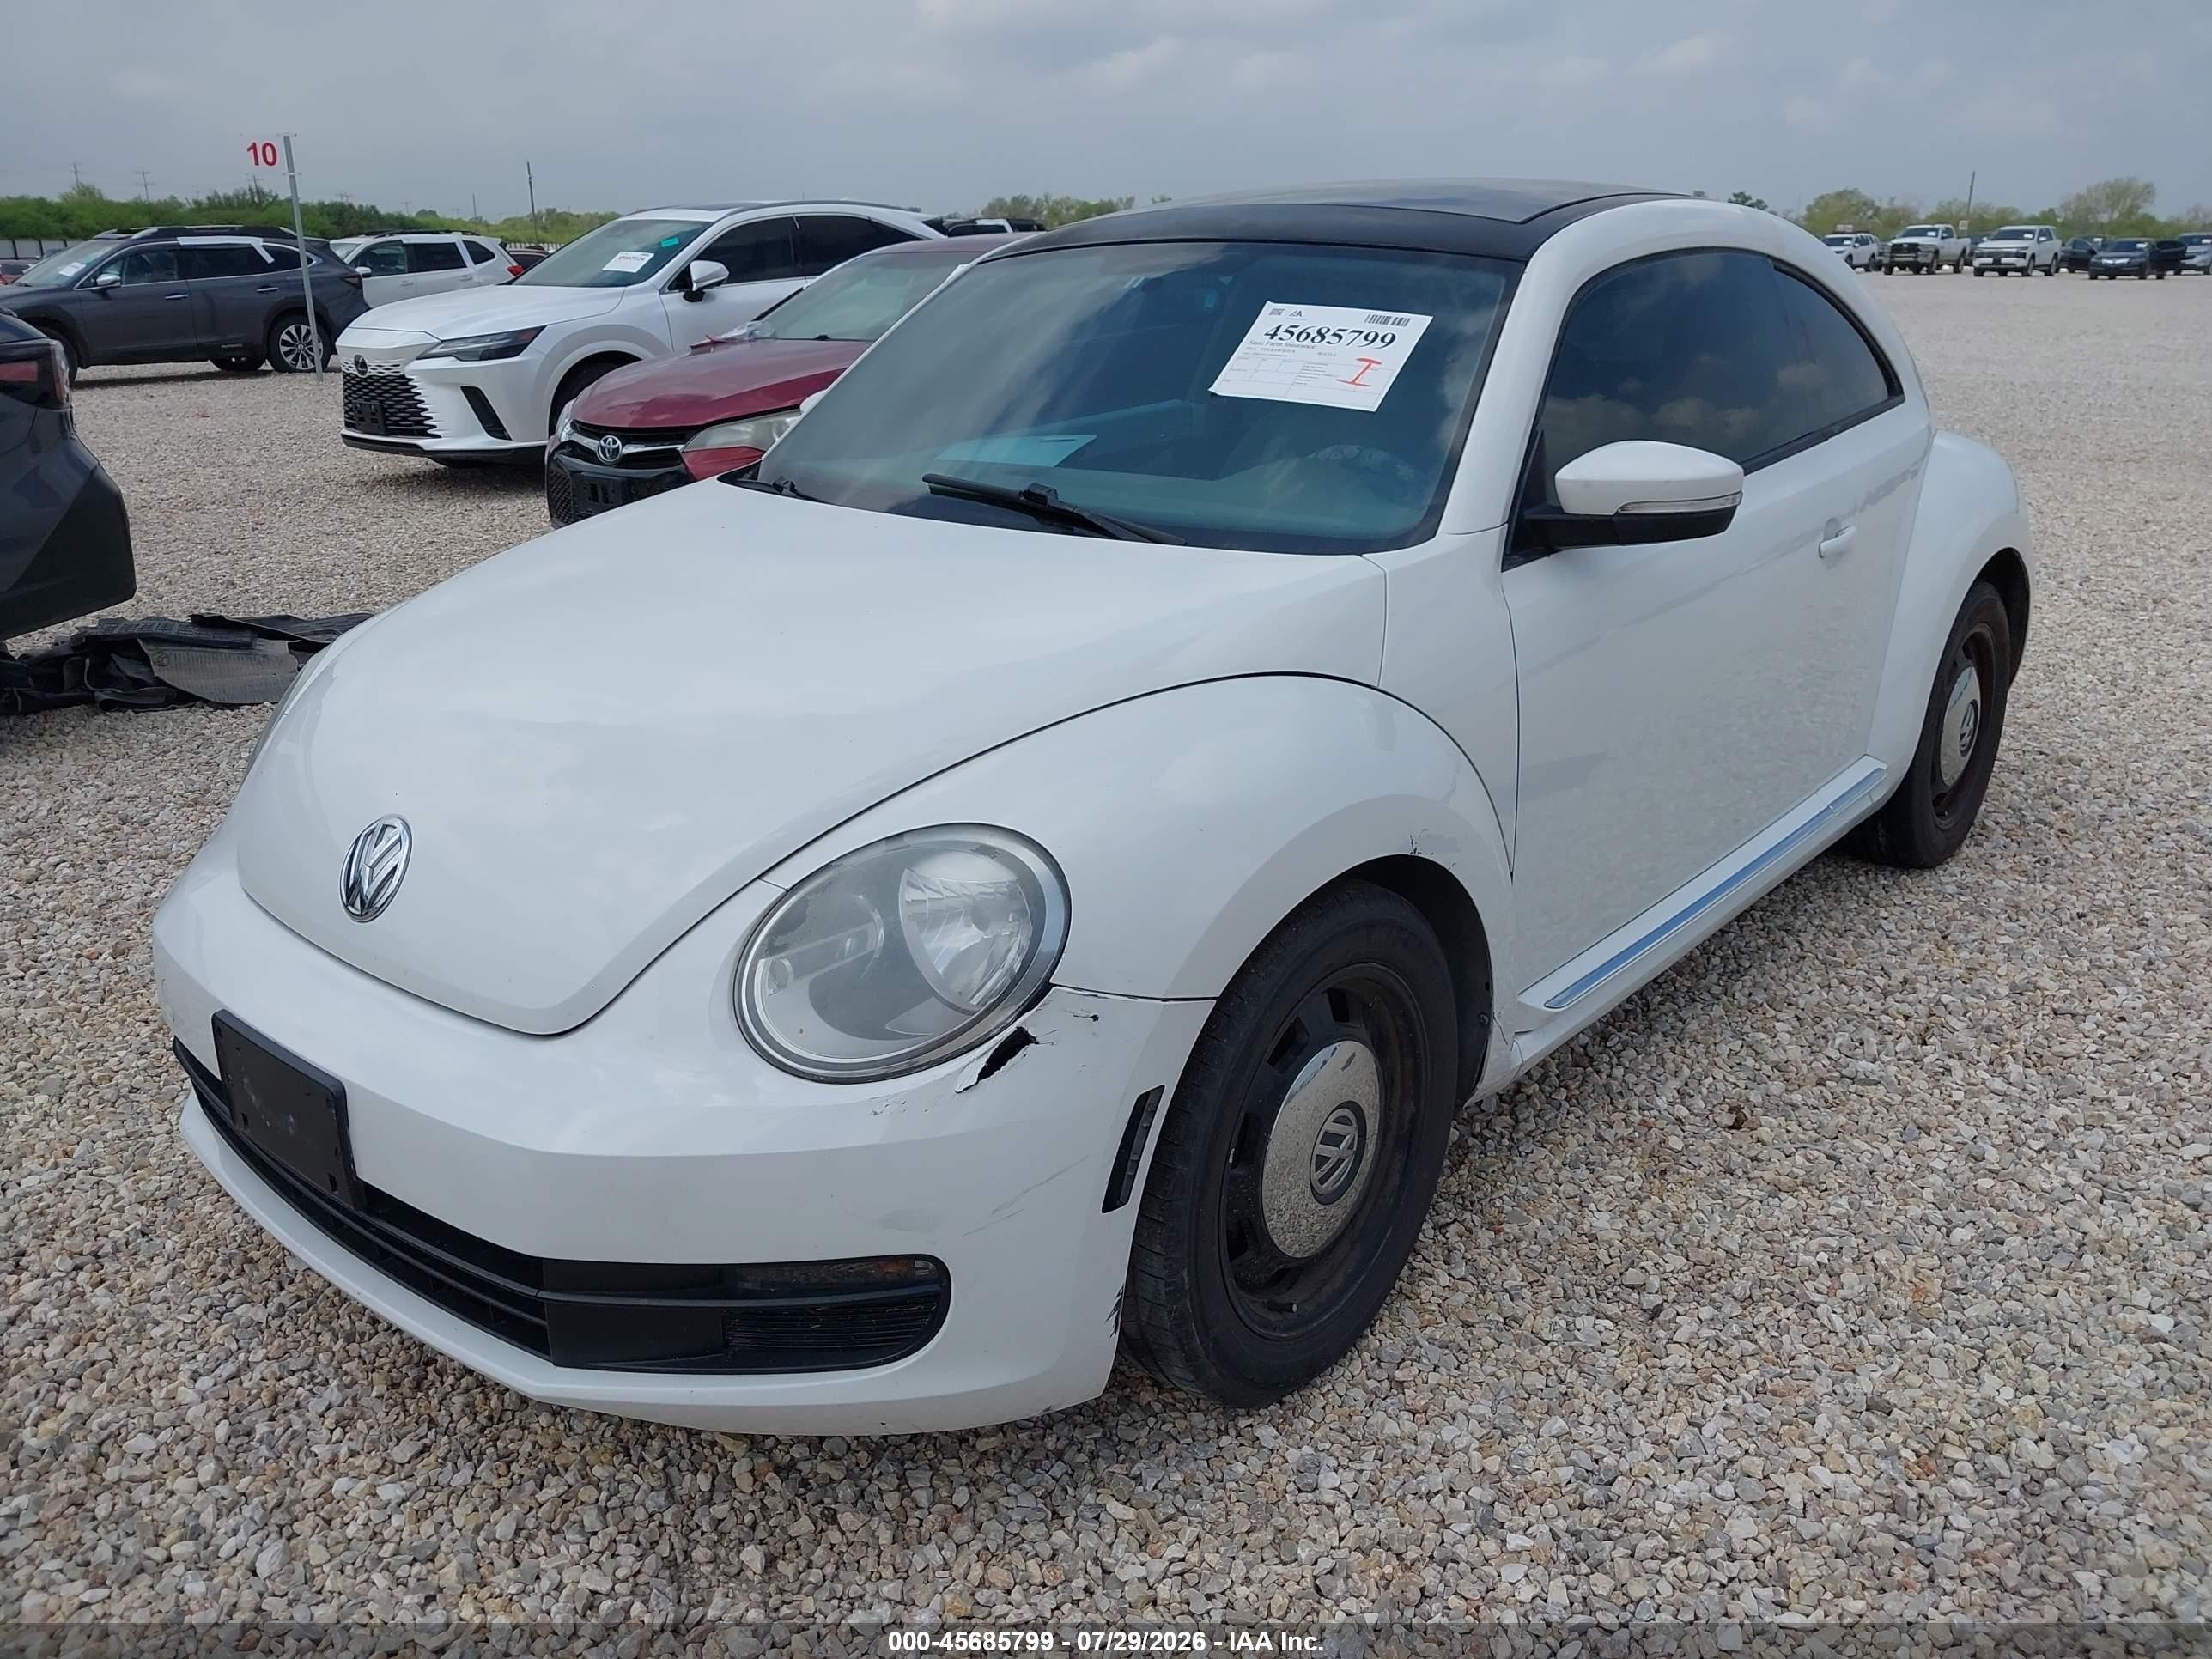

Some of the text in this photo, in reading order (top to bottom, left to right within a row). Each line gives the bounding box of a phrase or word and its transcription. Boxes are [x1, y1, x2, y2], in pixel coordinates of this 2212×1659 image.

[246, 142, 277, 167] 10
[1263, 324, 1396, 349] 45685799
[1284, 341, 1317, 349] Insurance
